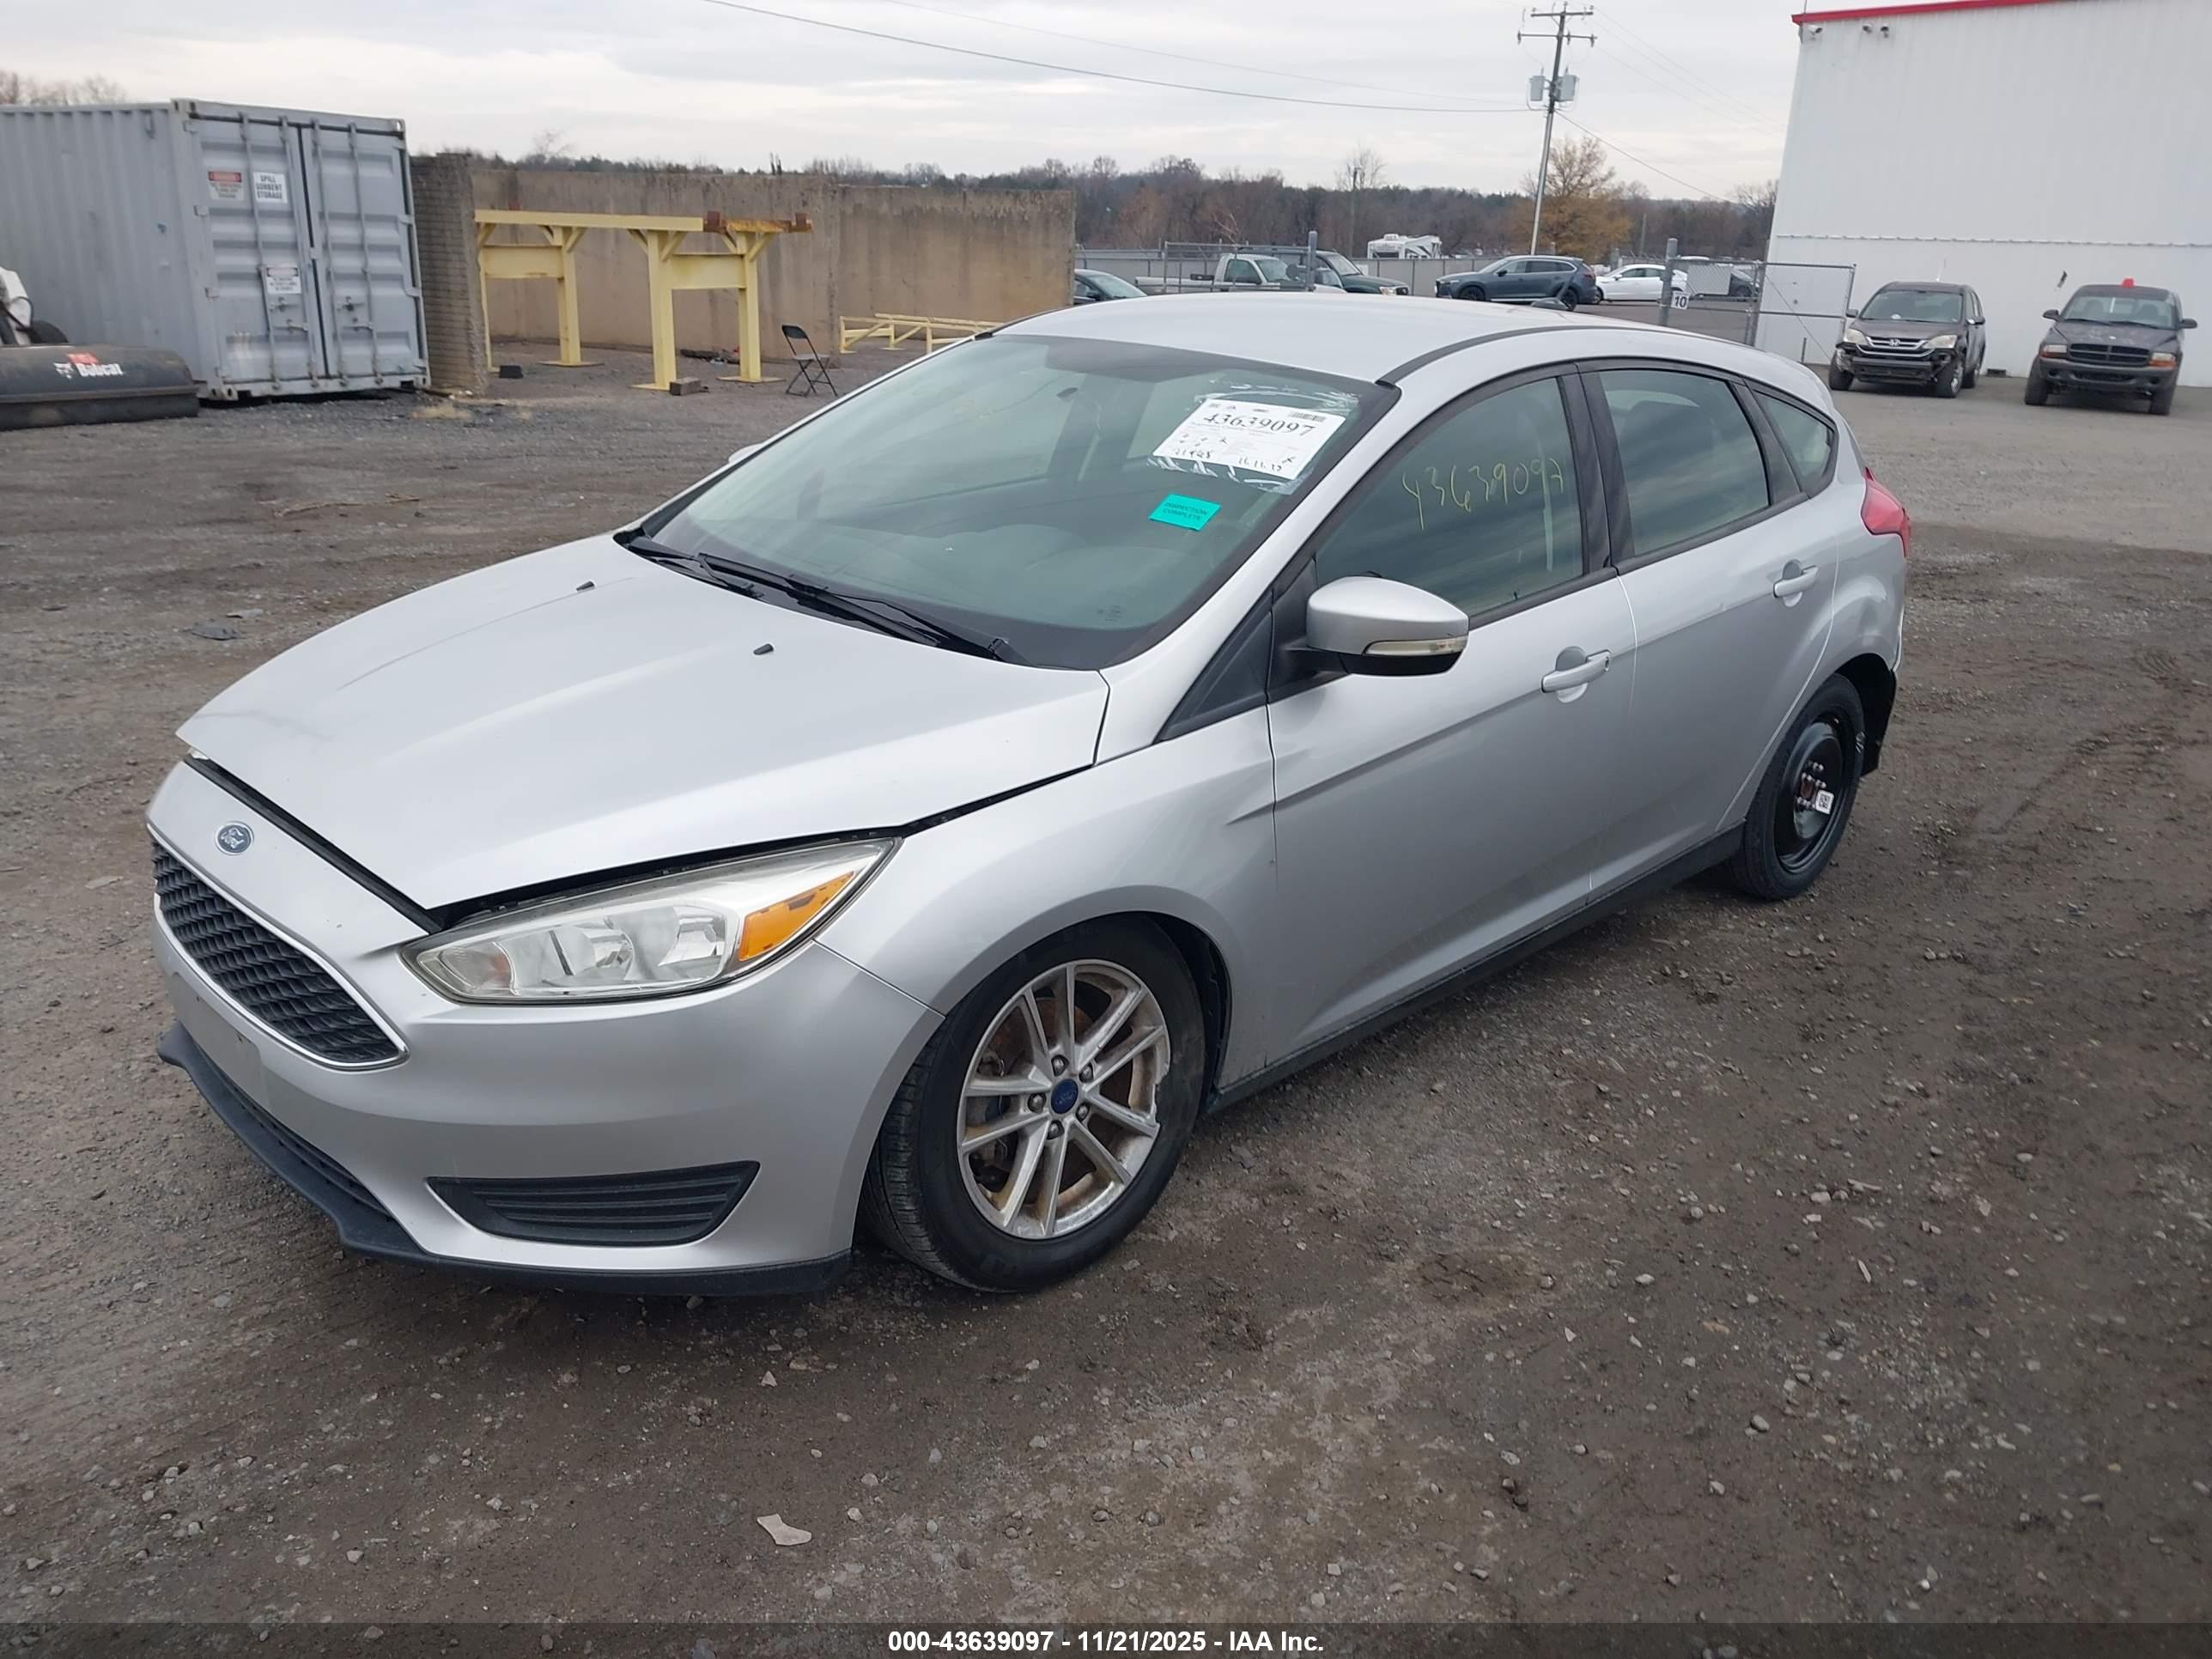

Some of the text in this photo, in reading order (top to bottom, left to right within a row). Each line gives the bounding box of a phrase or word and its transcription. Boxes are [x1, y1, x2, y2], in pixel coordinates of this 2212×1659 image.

[257, 191, 283, 199] STORAGE
[1674, 295, 1687, 308] 10
[75, 362, 124, 377] Bobcat
[1204, 412, 1316, 437] 43639097
[221, 827, 245, 849] Ford
